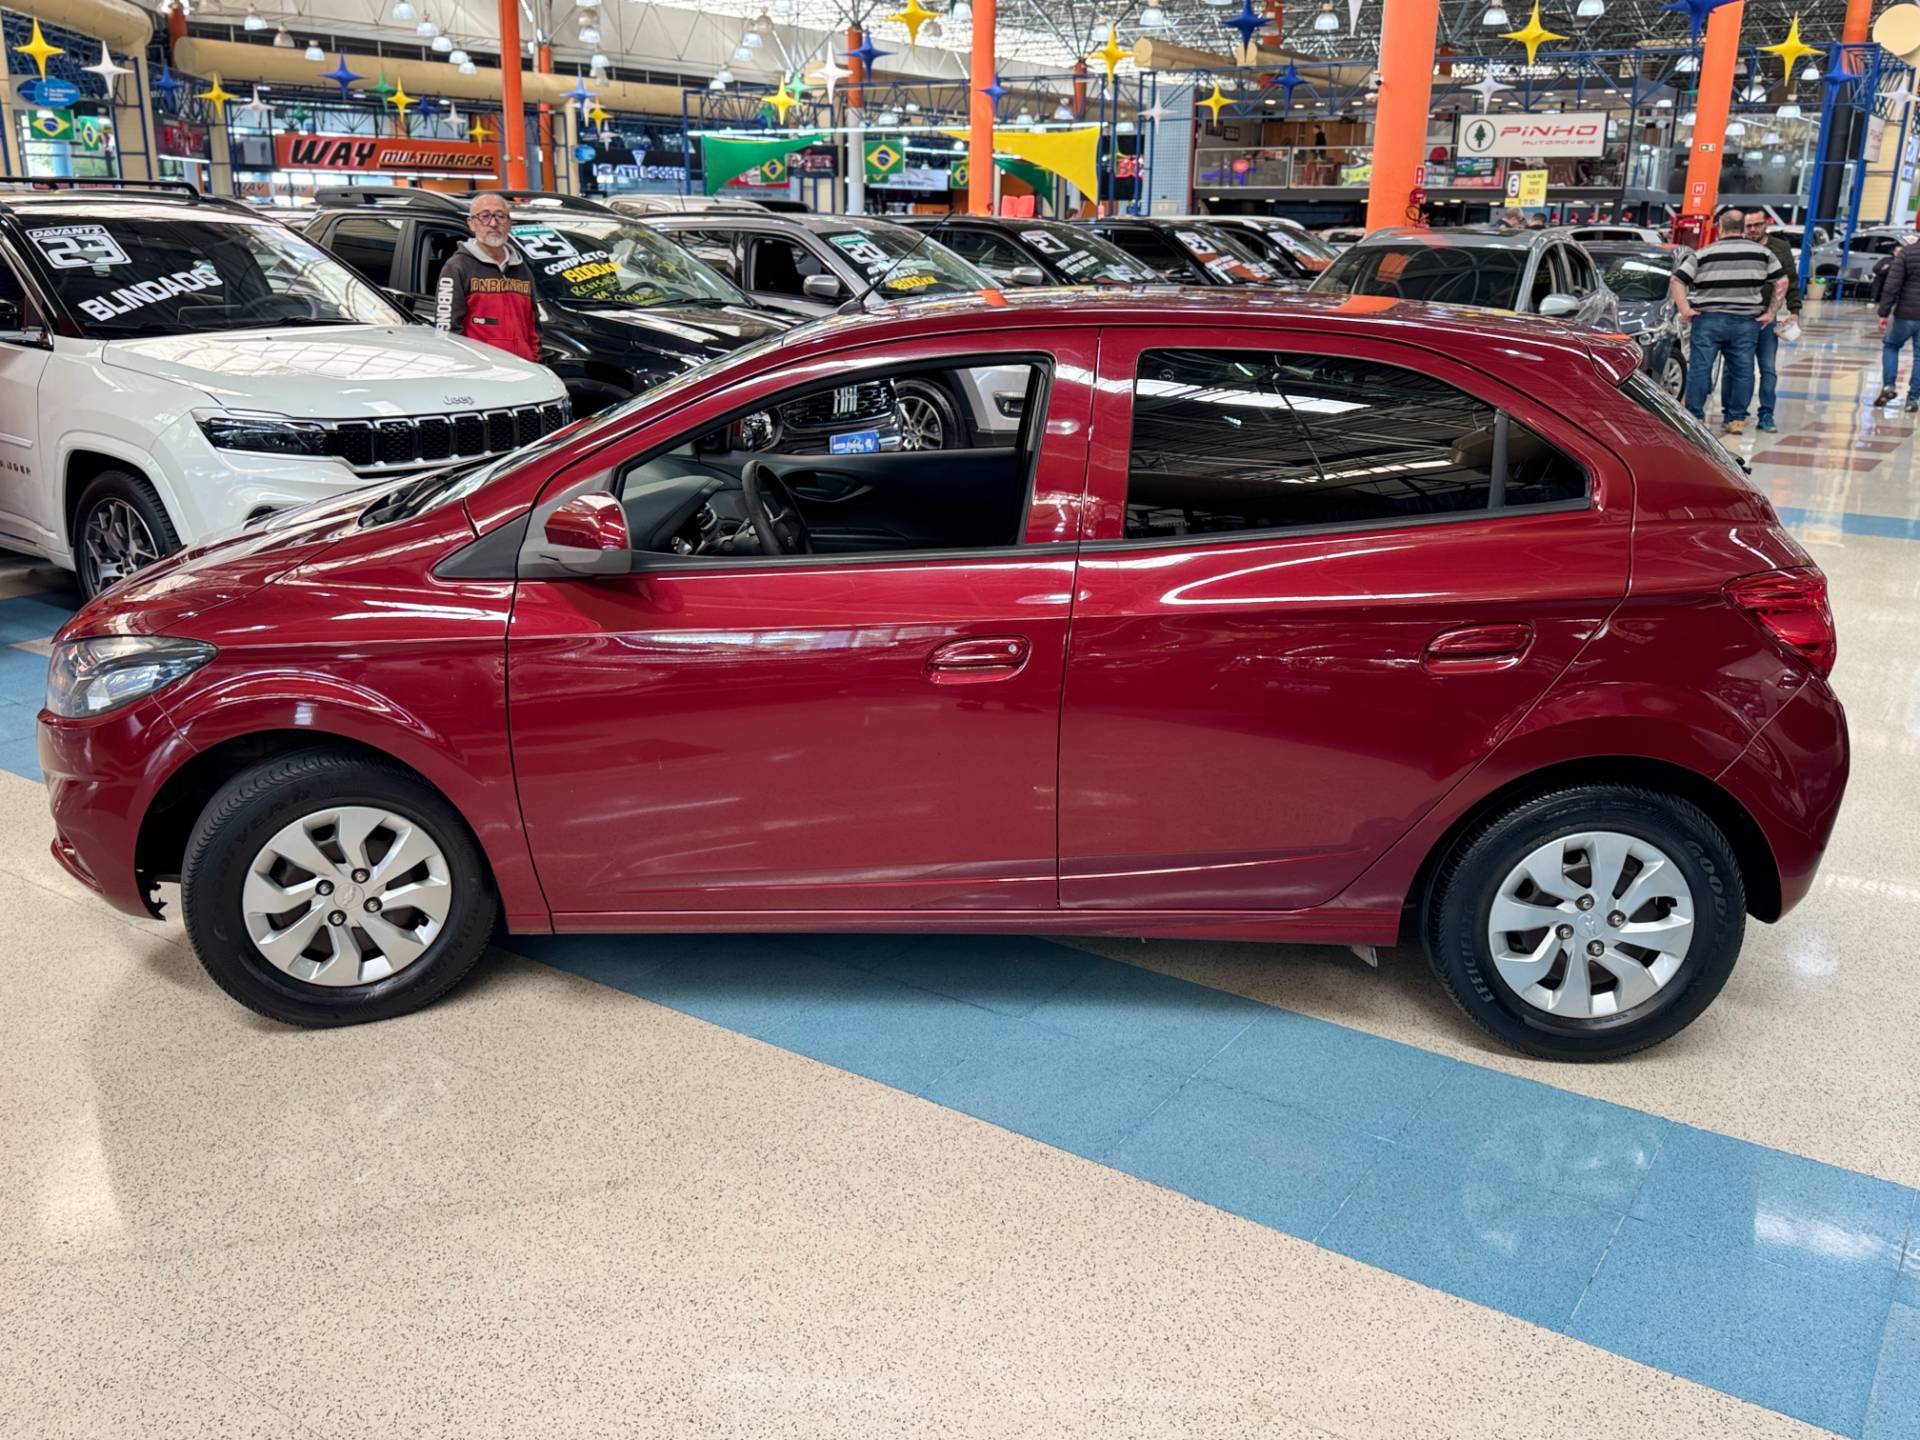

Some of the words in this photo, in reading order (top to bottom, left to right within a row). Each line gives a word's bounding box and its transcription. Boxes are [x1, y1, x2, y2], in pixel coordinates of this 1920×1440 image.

[291, 139, 376, 167] WAY
[379, 150, 494, 167] MULTIMARCAS
[40, 234, 126, 266] 23
[517, 232, 577, 258] 25
[842, 241, 888, 262] 20
[544, 250, 608, 275] COMPLETO
[78, 269, 223, 321] BLINDADO
[442, 395, 475, 406] Jeep
